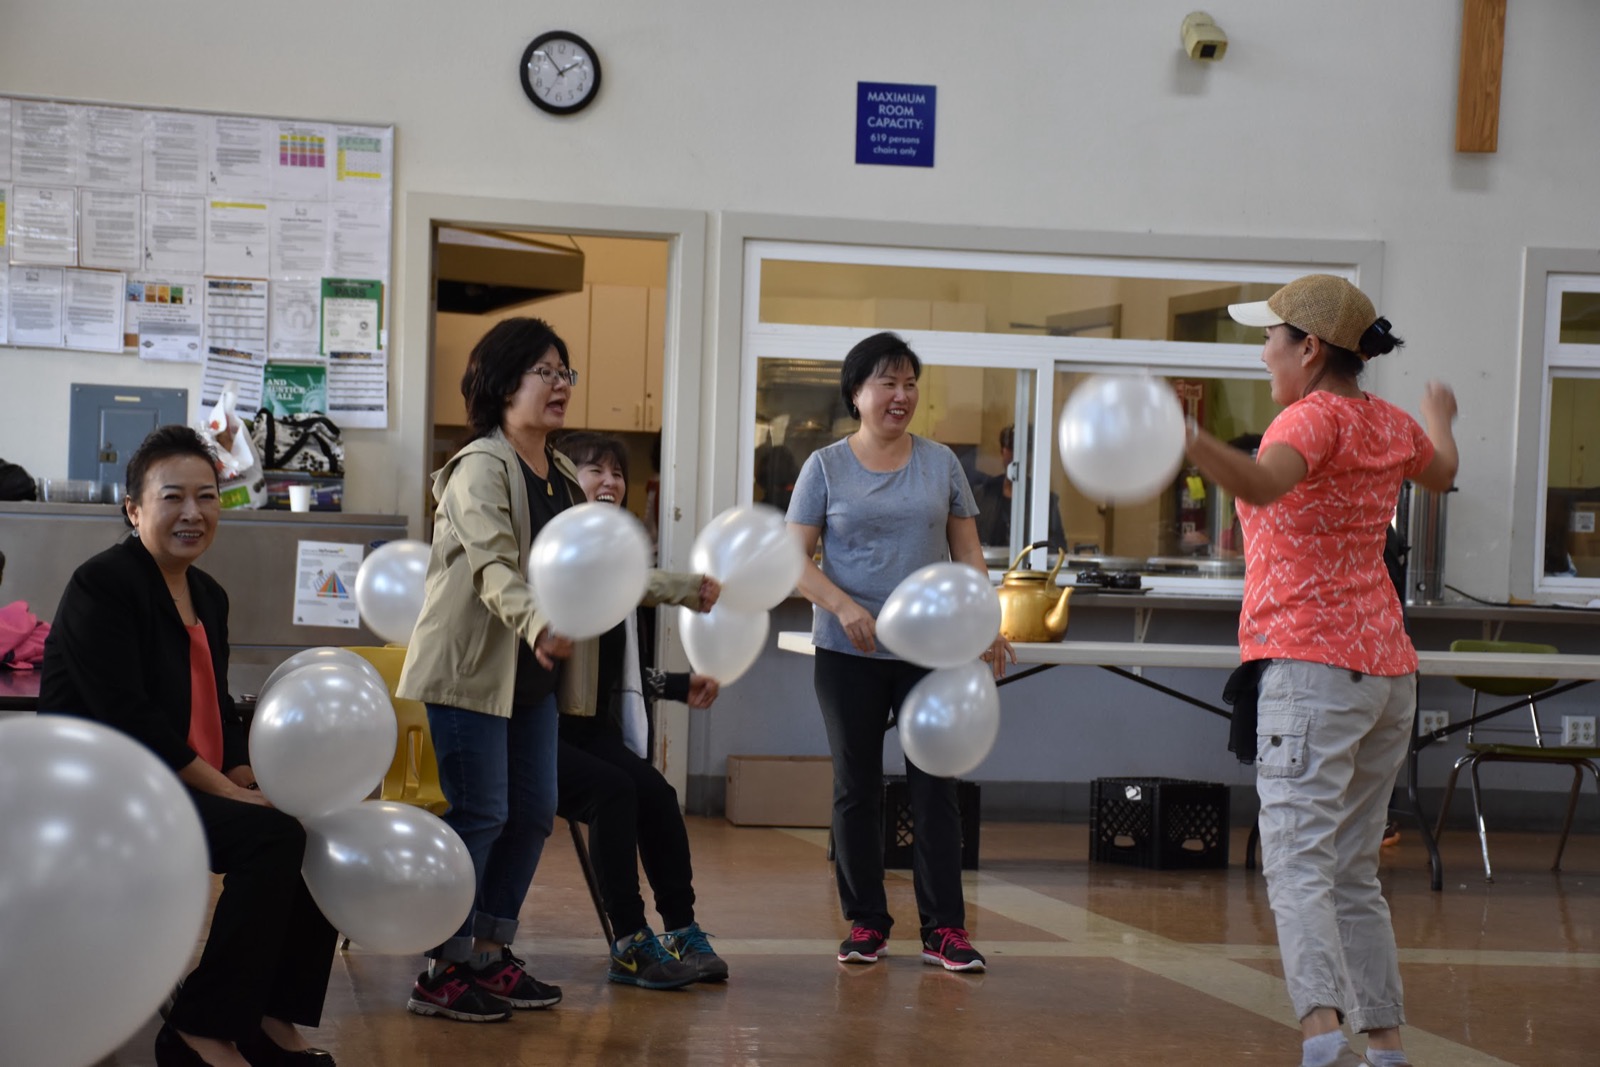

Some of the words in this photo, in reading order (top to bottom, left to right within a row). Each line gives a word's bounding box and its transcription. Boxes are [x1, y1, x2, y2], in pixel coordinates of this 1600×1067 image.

[555, 92, 562, 102] 6
[868, 92, 926, 104] MAXIMUM
[879, 105, 914, 116] ROOM
[868, 117, 924, 129] CAPACITY:
[870, 133, 887, 142] 619
[889, 136, 920, 144] persons
[874, 145, 898, 154] chairs
[900, 147, 917, 156] only
[335, 287, 367, 298] PASS
[266, 378, 288, 386] AND
